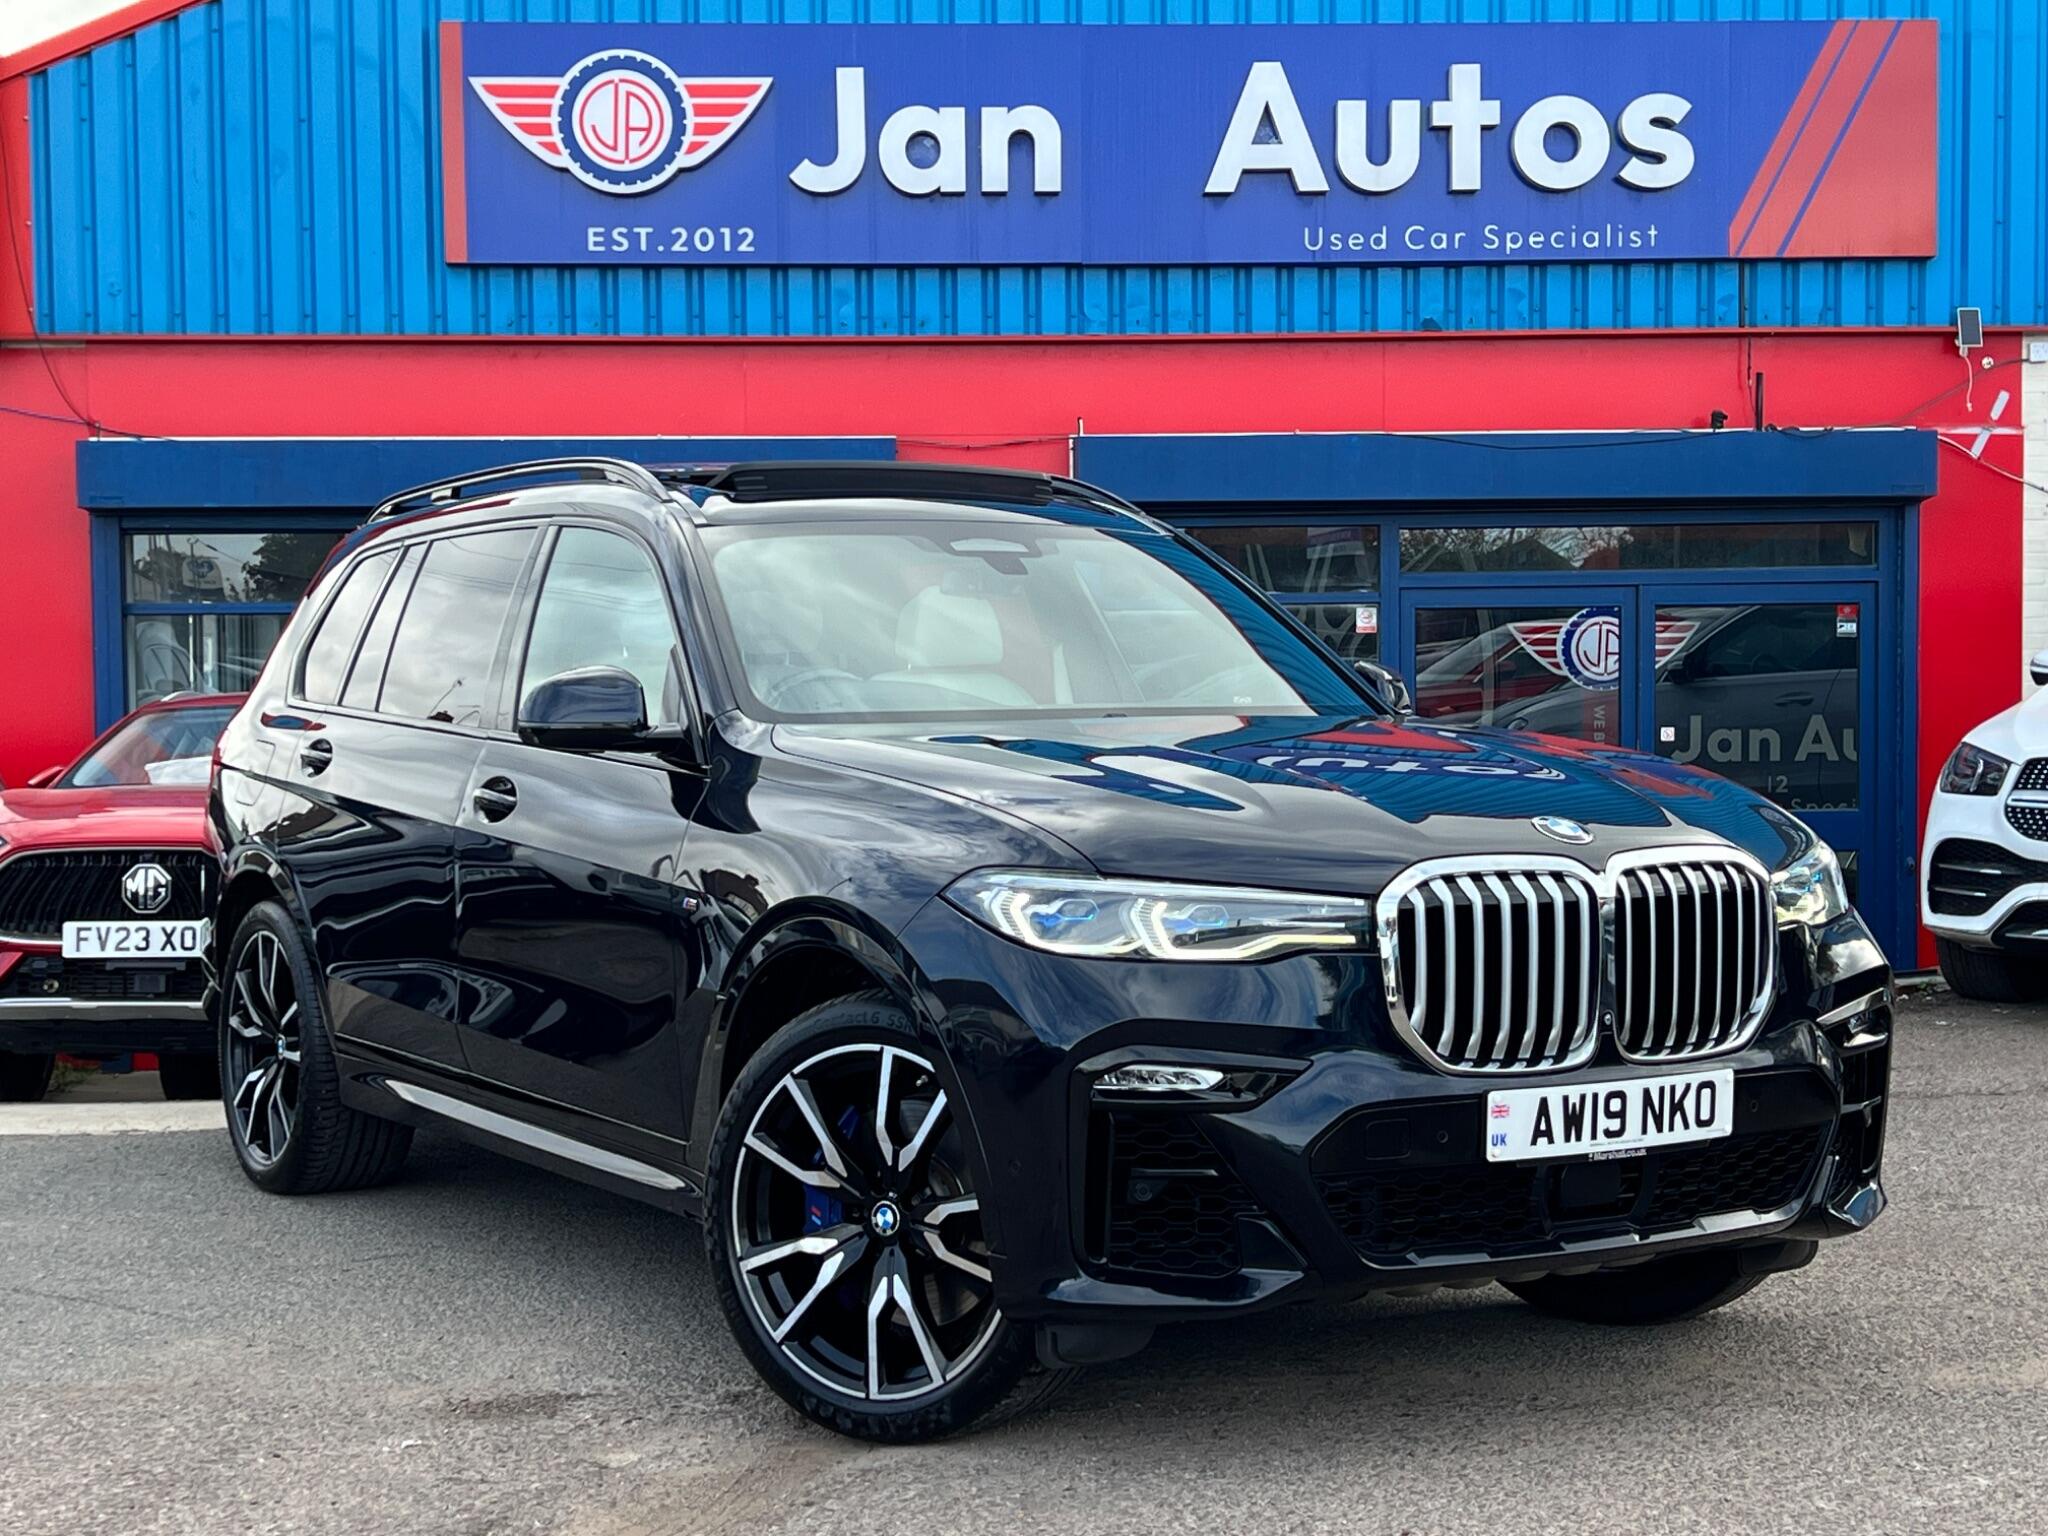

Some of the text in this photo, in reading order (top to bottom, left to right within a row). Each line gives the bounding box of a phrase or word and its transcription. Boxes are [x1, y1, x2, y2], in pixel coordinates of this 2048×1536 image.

[789, 60, 1695, 195] Jan Autos
[587, 226, 756, 253] EST.2012
[1303, 223, 1659, 254] Used Car Specialist
[1671, 714, 1781, 764] Jan
[125, 868, 167, 909] MG
[75, 926, 151, 952] FV23
[1529, 1079, 1717, 1147] AW19 NKO
[1491, 1132, 1507, 1147] UK
